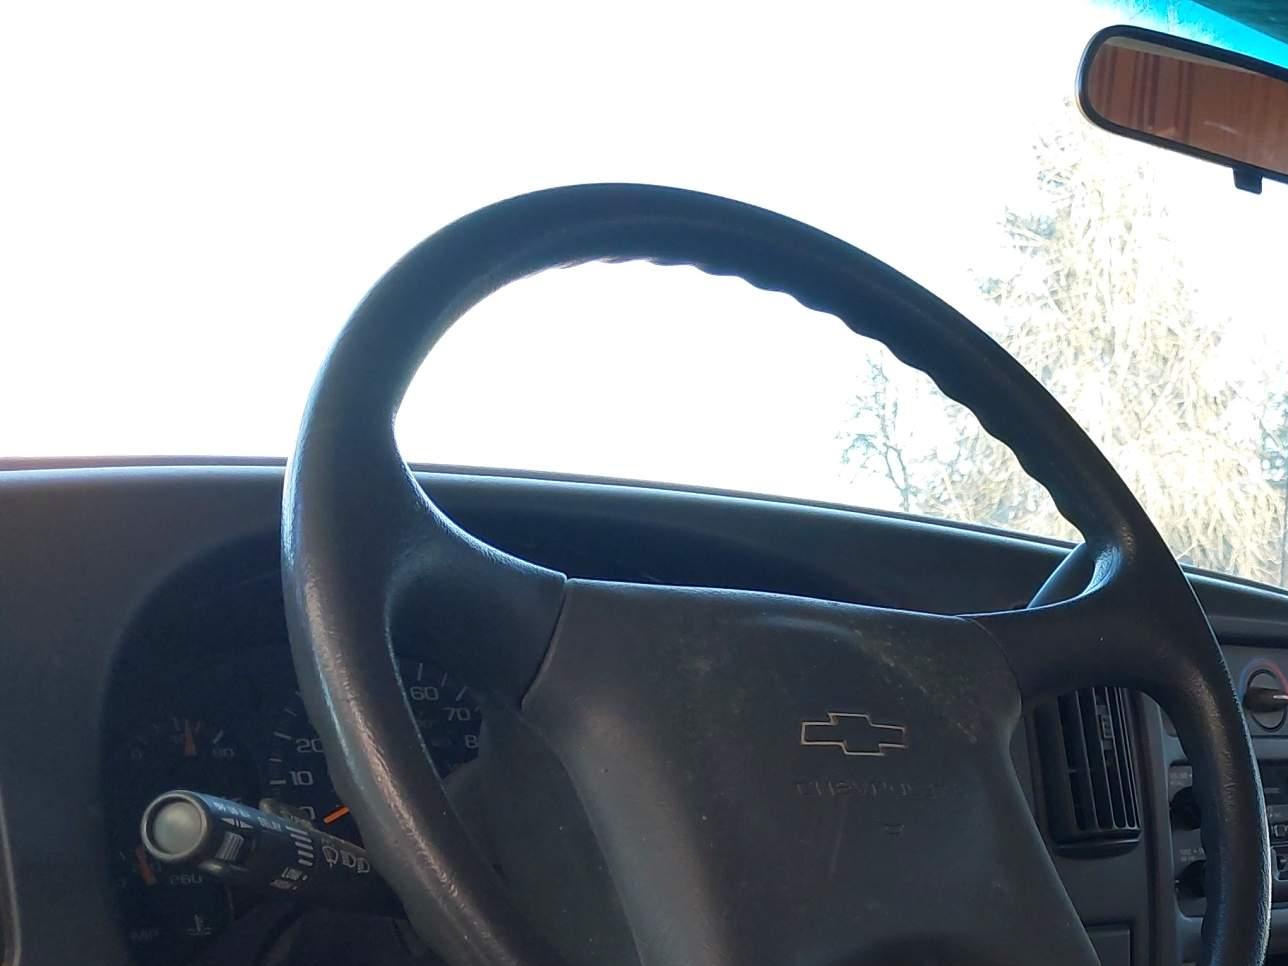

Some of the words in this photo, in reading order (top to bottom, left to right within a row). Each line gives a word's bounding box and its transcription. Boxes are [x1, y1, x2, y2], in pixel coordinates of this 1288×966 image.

[410, 686, 439, 701] 60
[442, 707, 471, 721] 70
[464, 734, 480, 749] 8
[289, 770, 314, 786] 10
